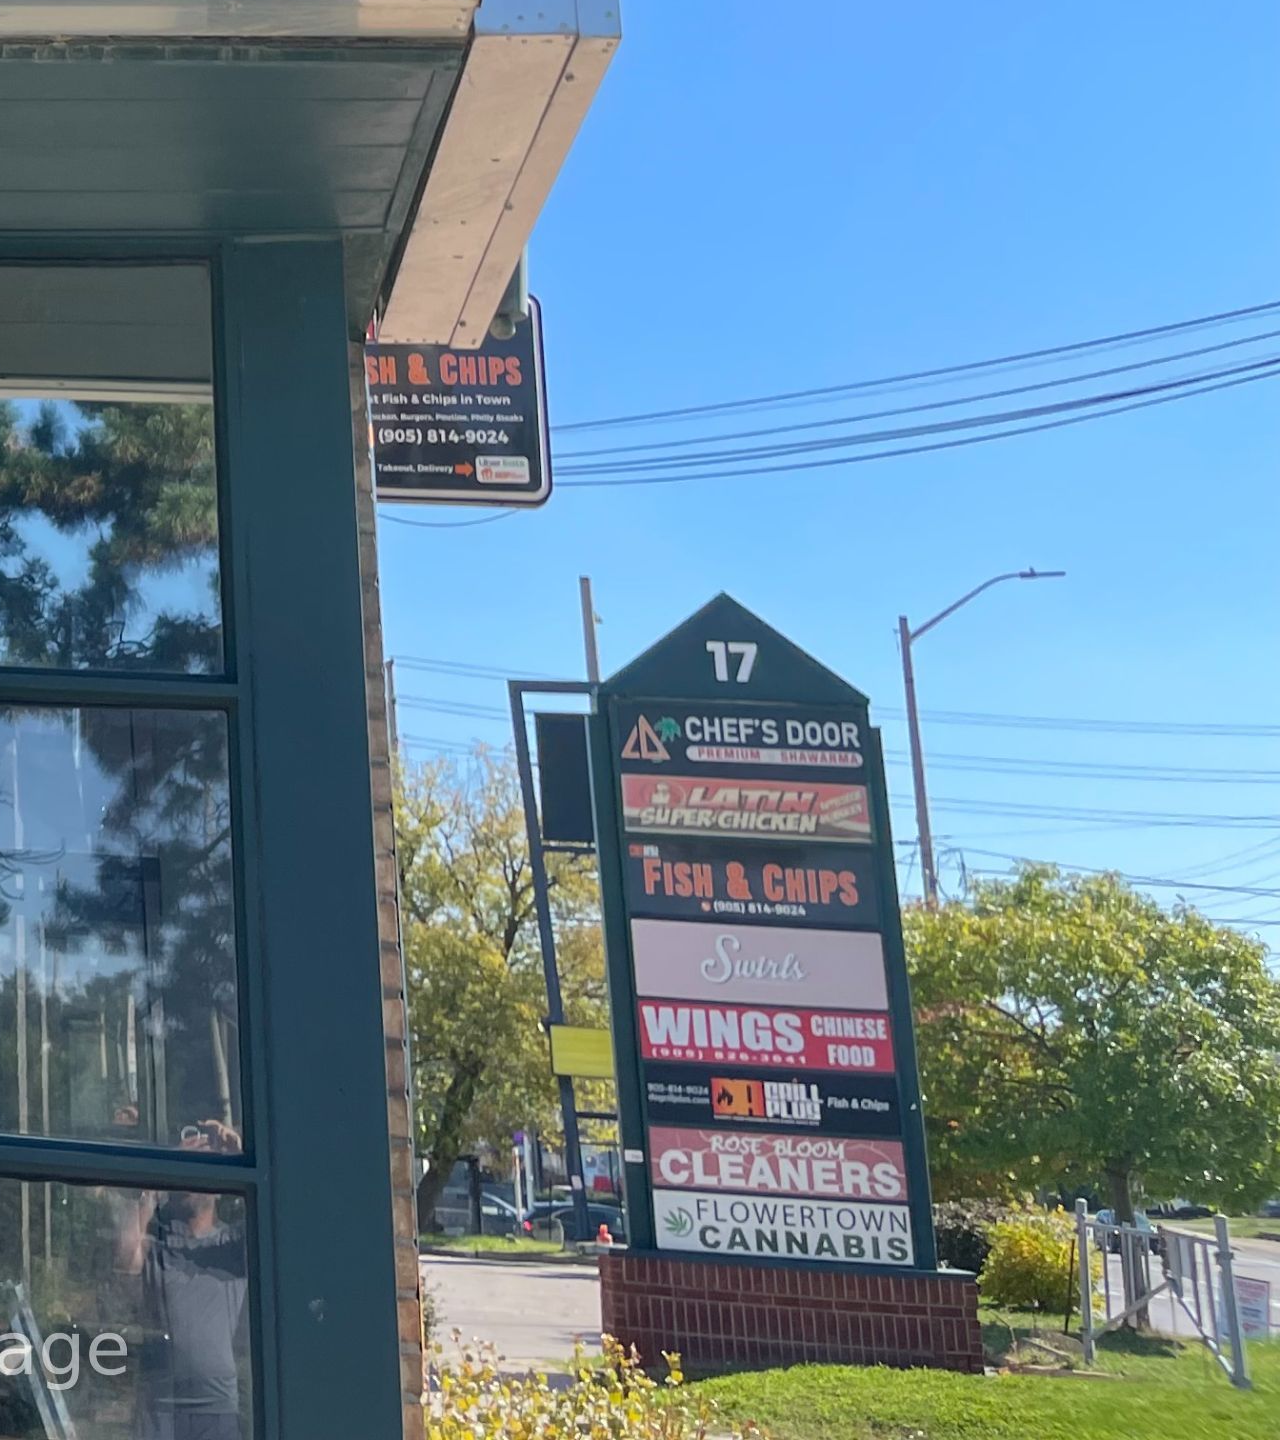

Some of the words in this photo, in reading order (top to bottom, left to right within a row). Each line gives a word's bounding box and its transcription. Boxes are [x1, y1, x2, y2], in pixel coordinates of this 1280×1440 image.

[408, 352, 431, 385] &
[440, 353, 522, 386] CHIPS
[382, 393, 407, 405] Fish
[411, 394, 419, 405] &
[422, 393, 457, 406] Chips
[460, 394, 472, 405] in
[475, 394, 511, 405] Town
[378, 428, 422, 445] (905)
[427, 429, 509, 445] 814-9024
[417, 463, 453, 474] Delivery
[706, 640, 757, 683] 17
[685, 716, 779, 744] CHEF'S
[786, 721, 861, 747] DOOR
[697, 746, 761, 760] PREMIUM
[780, 751, 858, 764] SHAWARMA
[688, 786, 818, 812] LATIN
[640, 807, 715, 827] SUPER
[718, 811, 818, 833] CHICKEN
[643, 856, 713, 898] FISH
[726, 861, 752, 900] &
[763, 863, 859, 905] CHIPS
[713, 900, 744, 914] (905)
[748, 902, 806, 916] 814-9024
[701, 935, 806, 983] Swirls
[642, 1005, 804, 1053] WINGS
[810, 1015, 887, 1040] CHINESE
[827, 1044, 875, 1067] FOOD
[827, 1097, 849, 1110] Fish
[851, 1099, 859, 1110] &
[860, 1099, 890, 1112] Chips
[710, 1136, 762, 1154] ROSE
[773, 1140, 845, 1160] BLOOM
[660, 1149, 901, 1197] CLEANERS
[696, 1198, 908, 1234] FLOWERTOWN
[699, 1225, 909, 1261] CANNABIS
